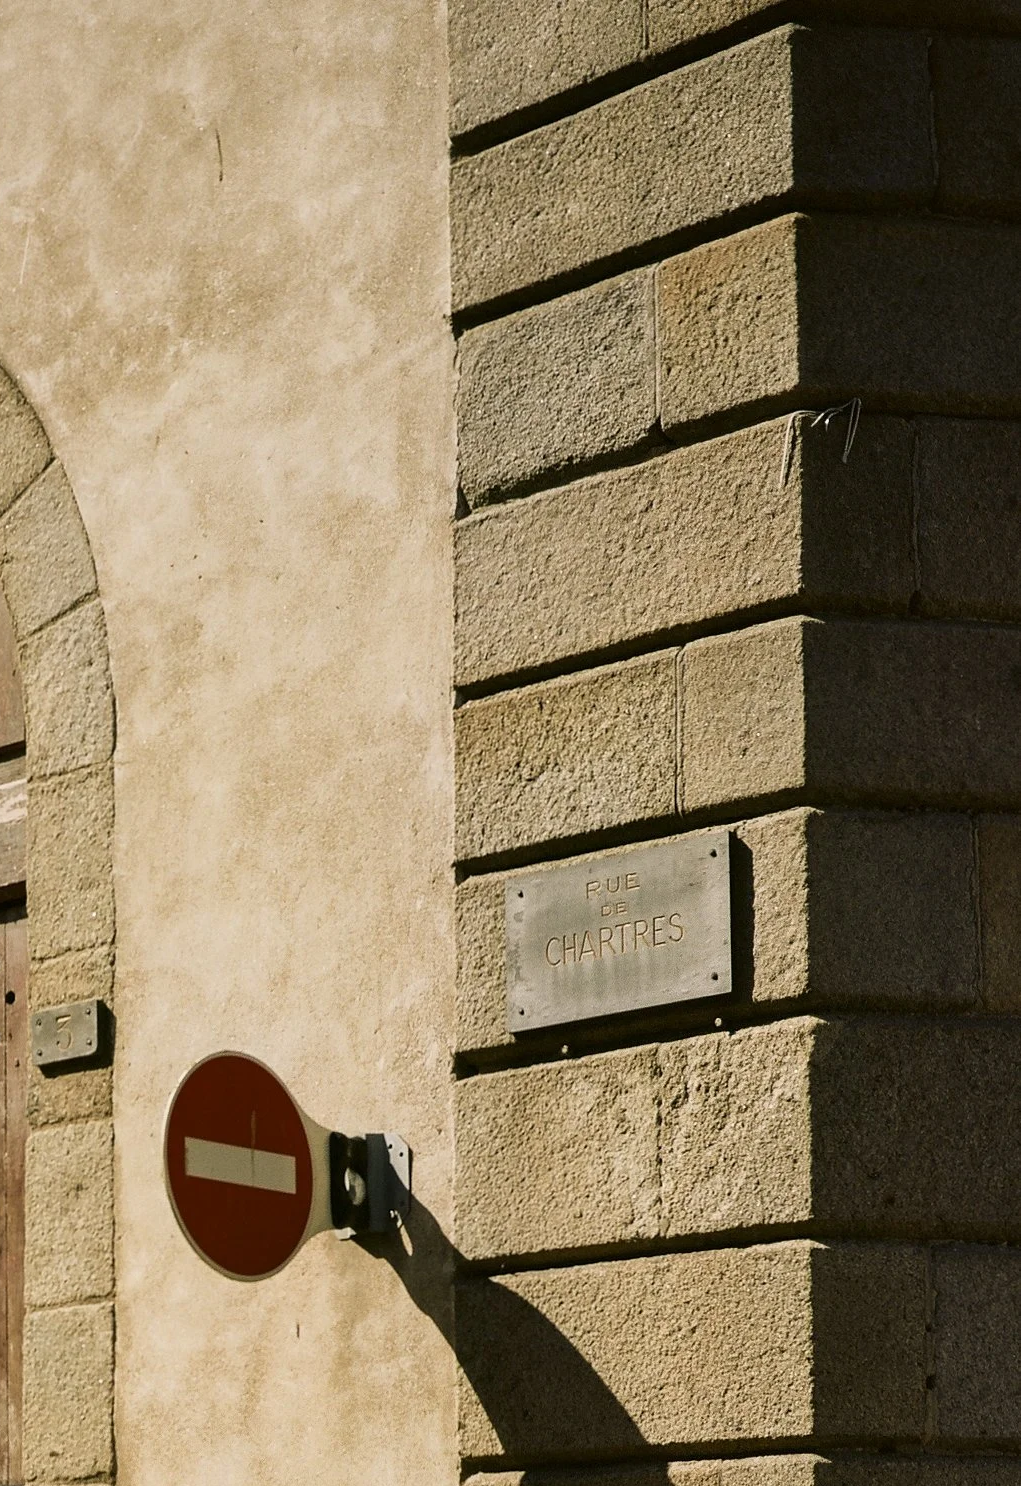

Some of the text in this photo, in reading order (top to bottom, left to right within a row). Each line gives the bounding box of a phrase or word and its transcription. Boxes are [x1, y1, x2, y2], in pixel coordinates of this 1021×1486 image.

[585, 871, 641, 899] RUE
[600, 901, 627, 917] DE
[545, 912, 684, 967] CHARTRES
[55, 1014, 72, 1051] 3
